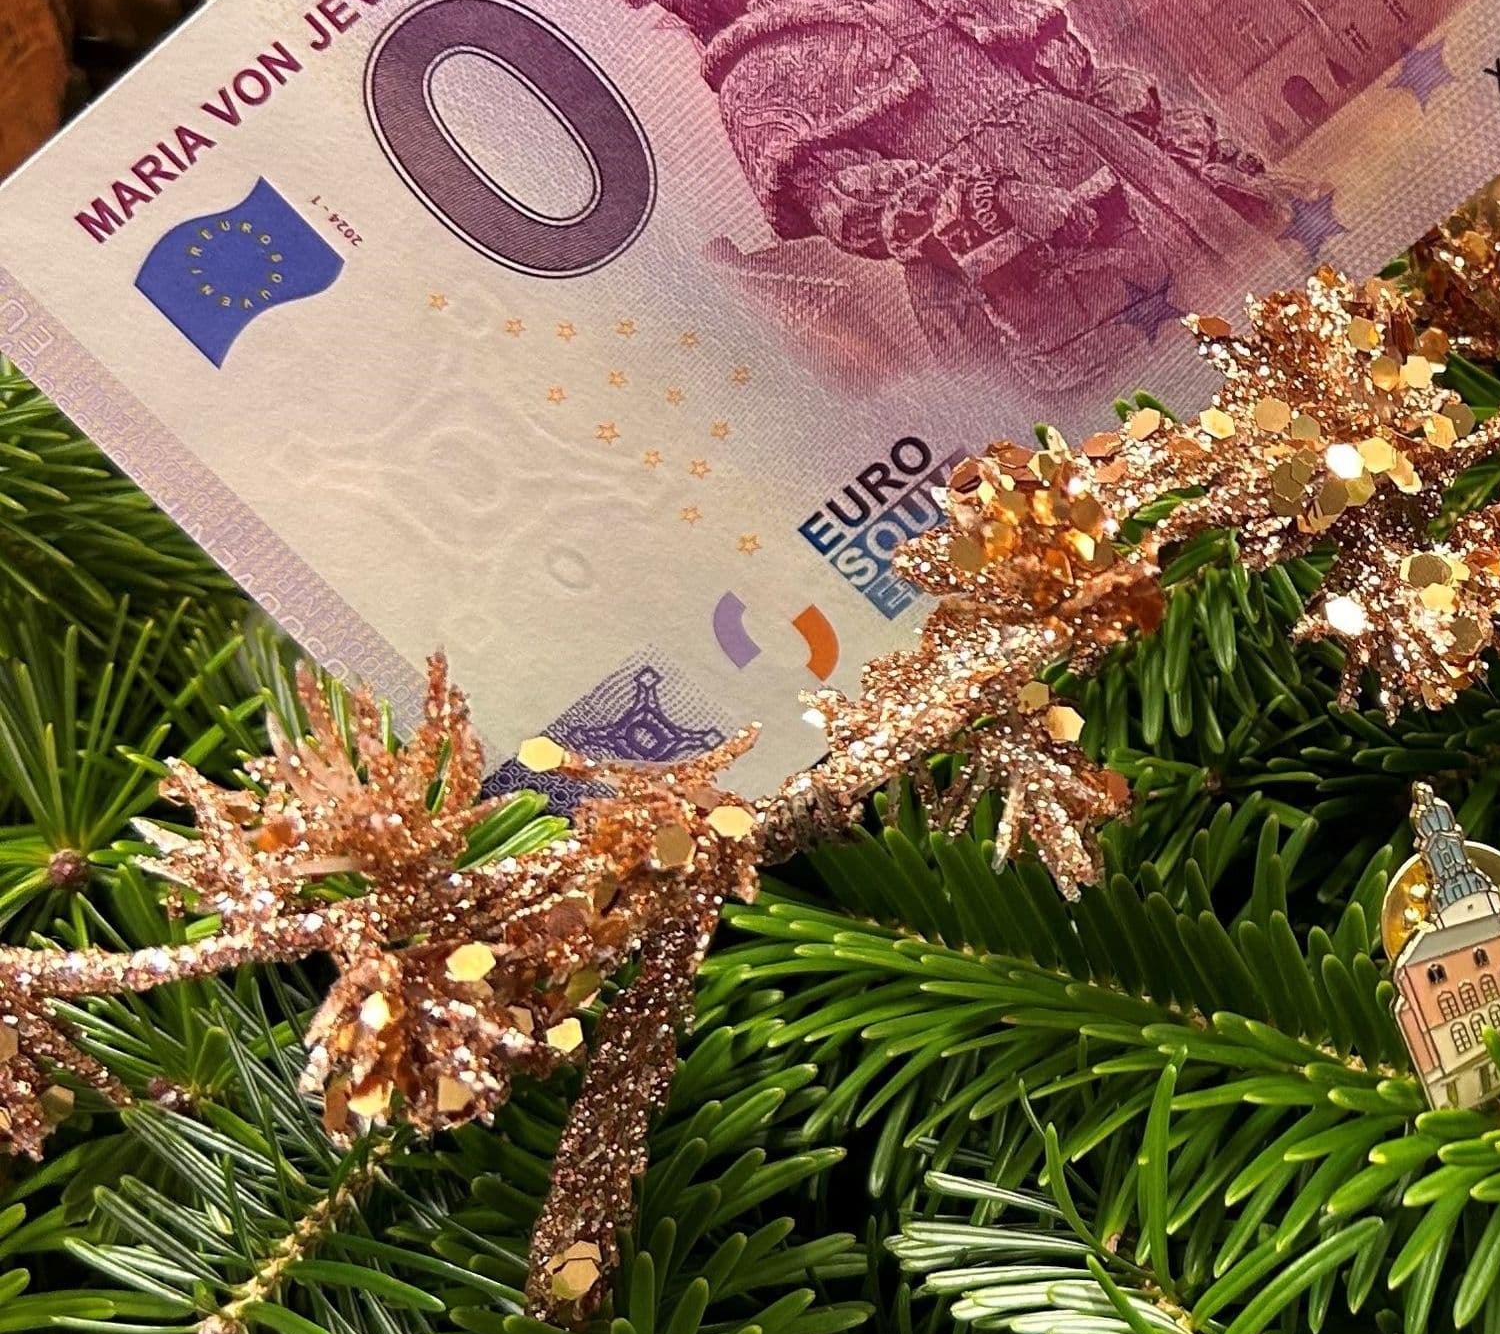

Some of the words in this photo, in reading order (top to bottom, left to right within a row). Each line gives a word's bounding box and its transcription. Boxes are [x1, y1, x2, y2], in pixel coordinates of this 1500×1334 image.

[74, 125, 217, 243] MARIA
[201, 42, 303, 128] VON
[798, 436, 932, 556] EURO
